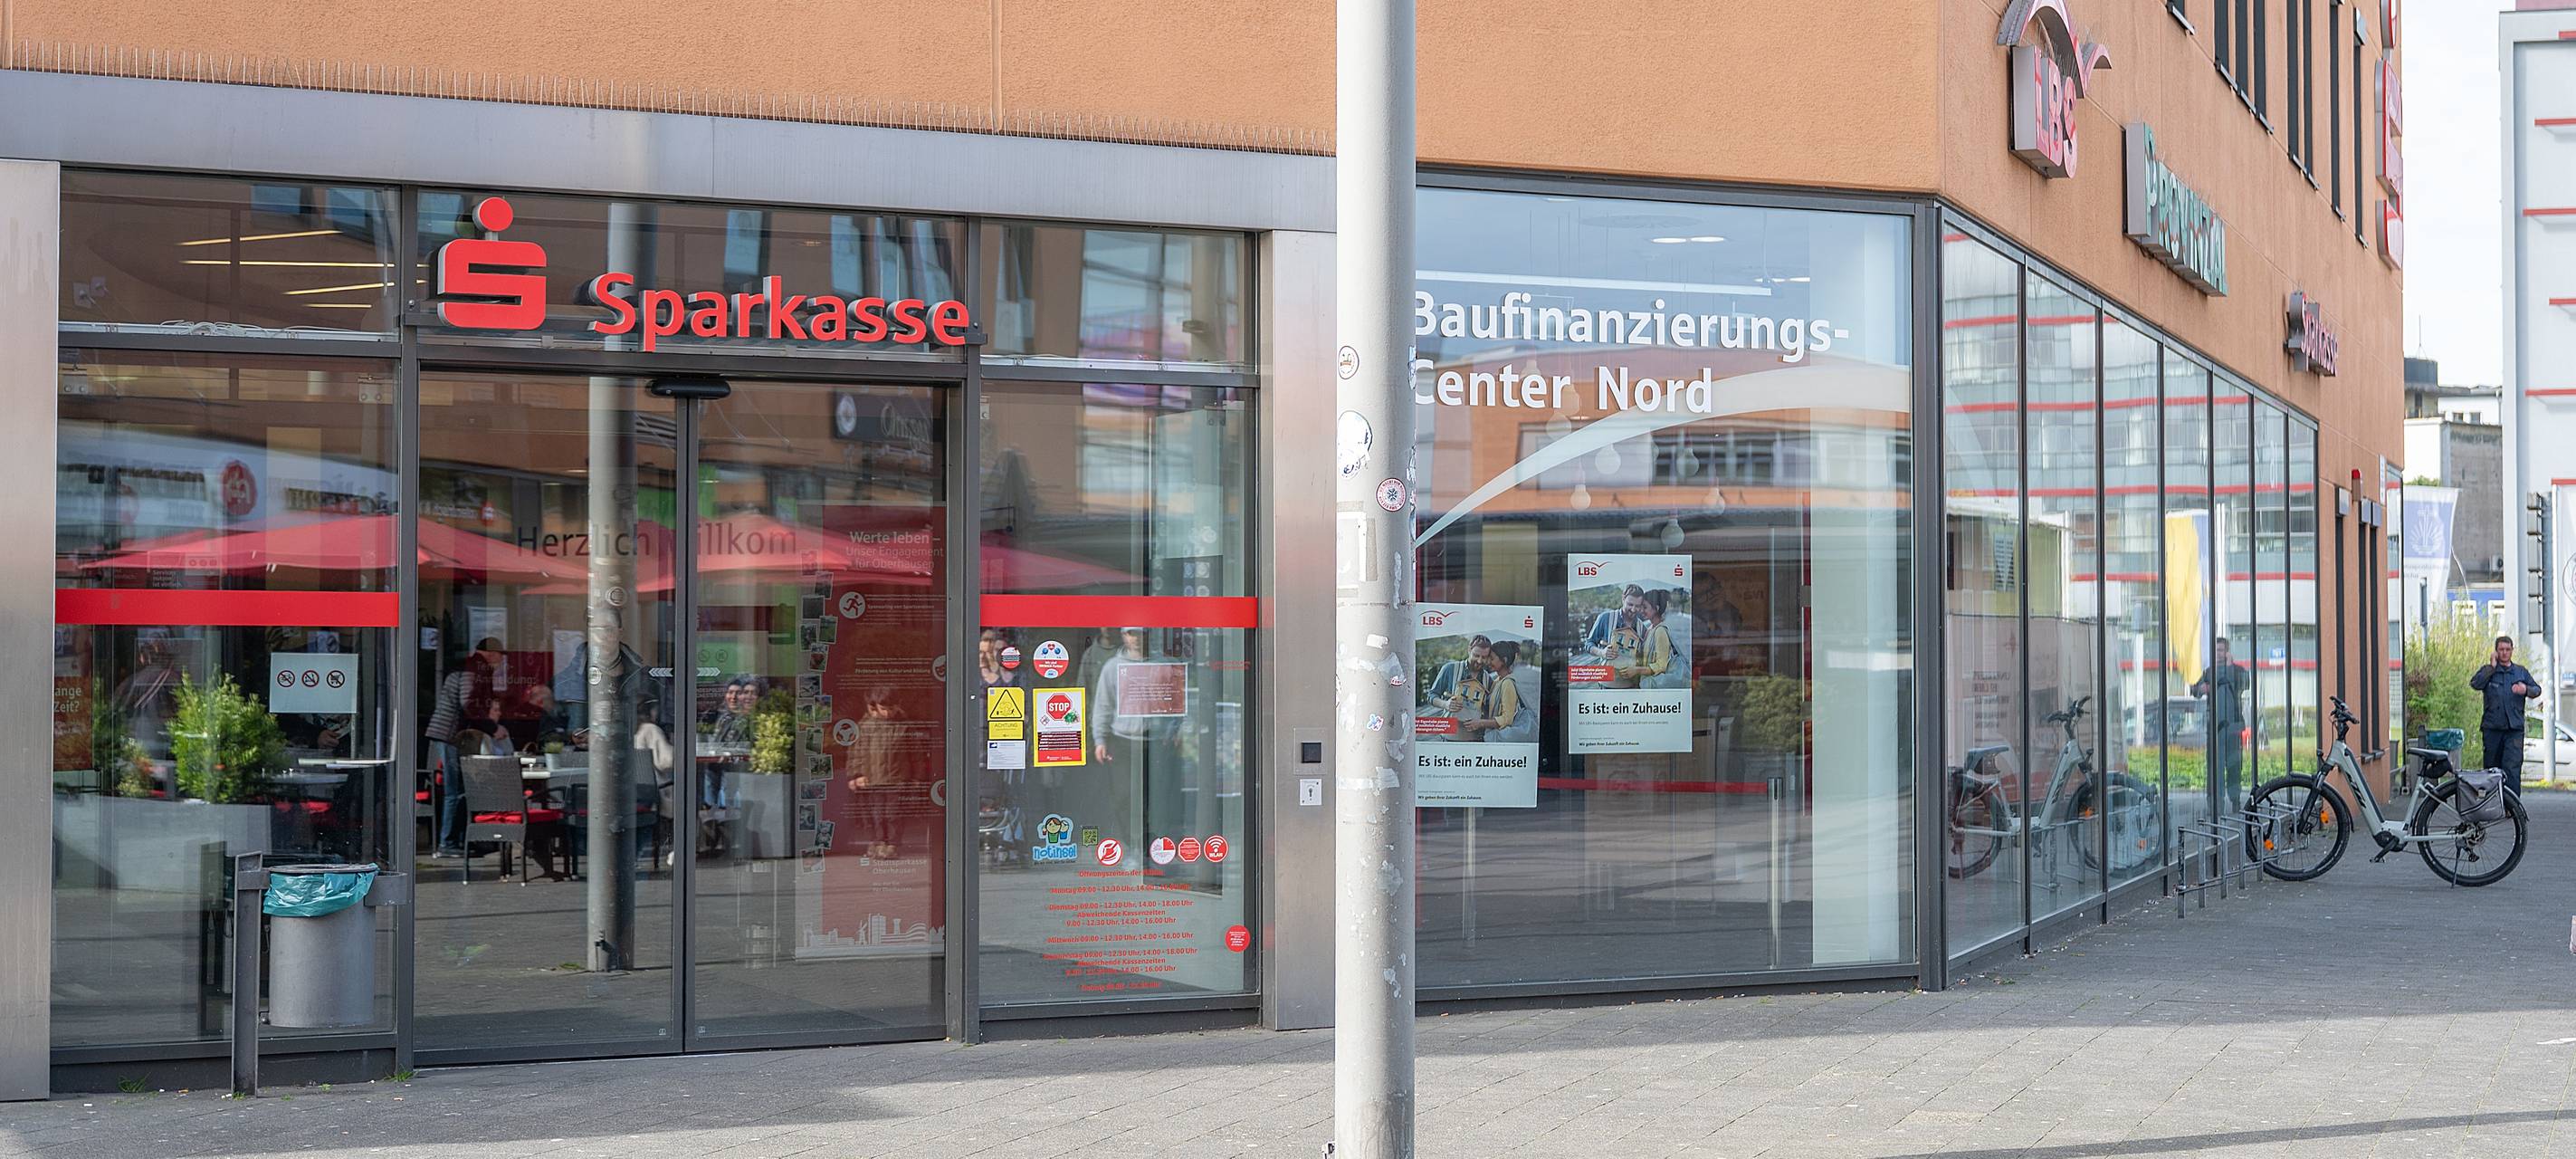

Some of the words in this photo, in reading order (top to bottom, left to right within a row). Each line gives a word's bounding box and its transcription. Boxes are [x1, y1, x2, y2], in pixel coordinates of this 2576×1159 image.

[2034, 45, 2078, 179] LBS
[588, 273, 970, 352] Sparkasse
[1415, 291, 1850, 363] Baufinanzierungs-
[1415, 359, 1571, 409] Center
[1598, 365, 1713, 414] Nord
[518, 524, 650, 557] Herzlich
[698, 522, 797, 555] illkom
[850, 532, 891, 544] Werte
[893, 531, 930, 544] leben
[846, 547, 877, 557] Unser
[880, 547, 944, 559] Engagement
[867, 558, 935, 570] Oberhausen
[1578, 567, 1598, 576] LBS
[1422, 617, 1443, 626] LBS
[53, 685, 82, 699] ange
[53, 701, 81, 713] Zeit?
[1048, 703, 1070, 712] STOP
[1579, 703, 1590, 714] Es
[1593, 703, 1609, 714] ist:
[1613, 703, 1629, 714] ein
[1632, 702, 1682, 714] Zuhause!
[1418, 755, 1430, 767] Es
[1434, 755, 1451, 767] ist:
[1455, 755, 1472, 767] ein
[1475, 755, 1527, 768] Zuhause!
[1034, 845, 1076, 860] notinsel
